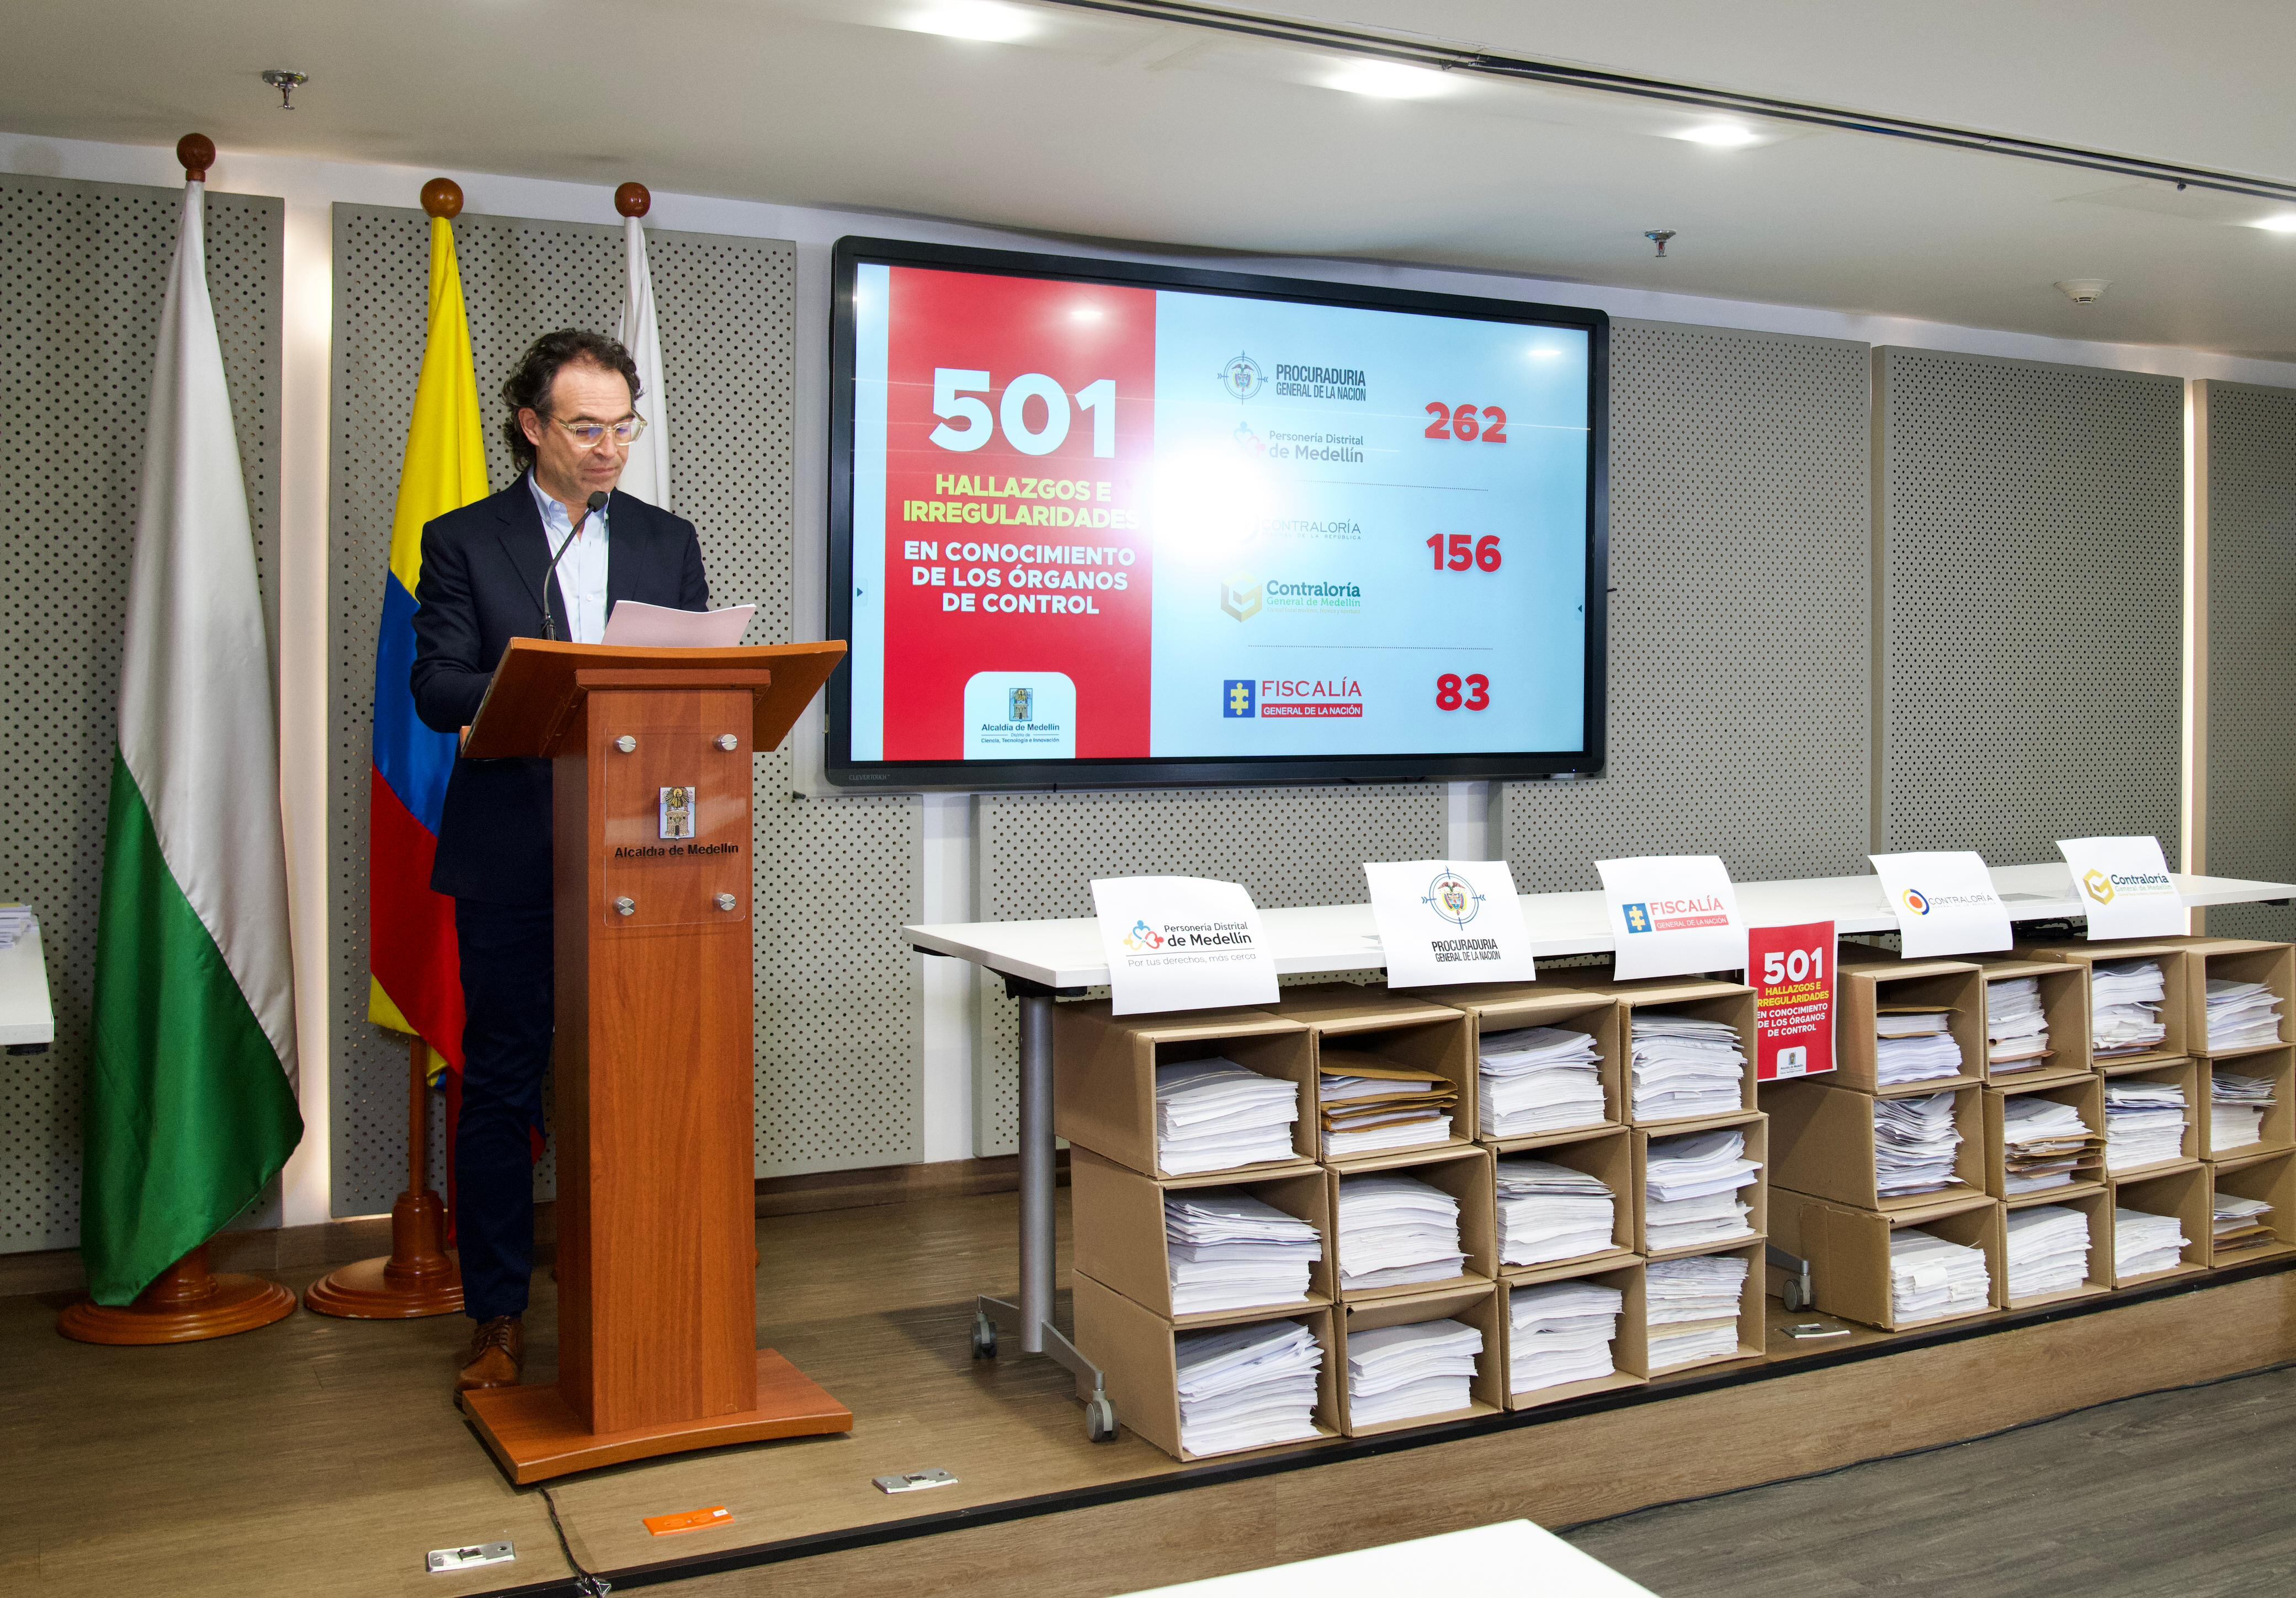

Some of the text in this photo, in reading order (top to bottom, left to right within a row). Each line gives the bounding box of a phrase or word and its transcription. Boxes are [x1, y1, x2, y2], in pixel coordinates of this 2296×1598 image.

[1276, 364, 1366, 386] PROCURADURIA
[1276, 382, 1366, 401] GENERAL DE LA NACION
[929, 367, 1116, 459] 501
[1425, 402, 1507, 443] 262
[1269, 430, 1363, 445] Personería Distrital
[1269, 443, 1363, 462] de Medellín
[936, 474, 1111, 502] HALLAZGOS E
[903, 500, 1140, 529] IRREGULARIDADES
[1262, 519, 1361, 534] CONTRALORÍA
[905, 541, 1135, 566] EN CONOCIMIENTO
[1426, 534, 1501, 572] 156
[912, 564, 1128, 590] DE LOS ÓRGANOS
[1267, 580, 1360, 597] Contraloría
[943, 593, 1099, 614] DE CONTROL
[1267, 597, 1303, 605] General
[1321, 598, 1360, 606] Medellín
[1262, 677, 1362, 697] FISCALÍA
[1436, 673, 1490, 711] 83
[1330, 705, 1360, 715] NACIÓN
[669, 845, 683, 855] de
[2111, 873, 2169, 885] Contraloría
[1650, 895, 1724, 915] FISCALÍA
[1928, 892, 1994, 905] CONTRALORÍA
[1164, 921, 1248, 933] Personería Distrital
[1657, 920, 1686, 929] GENERAL
[1704, 917, 1726, 925] NACIÓN
[1167, 931, 1252, 947] de Medellín
[1432, 939, 1498, 952] PROCURADURIA
[1128, 959, 1143, 967] Por
[1163, 956, 1207, 965] derechos,
[1209, 954, 1229, 962] más
[1436, 950, 1501, 962] GENERAL DE LA NACION
[1763, 947, 1822, 985] 501
[1766, 982, 1815, 996] HALLAZGOS
[1757, 990, 1829, 1007] RREGULARIDADES
[1769, 1003, 1828, 1018] CONOCIMIENTO
[1758, 1013, 1825, 1029] DE LOS ÓRGANOS
[1781, 1024, 1816, 1036] CONTROL
